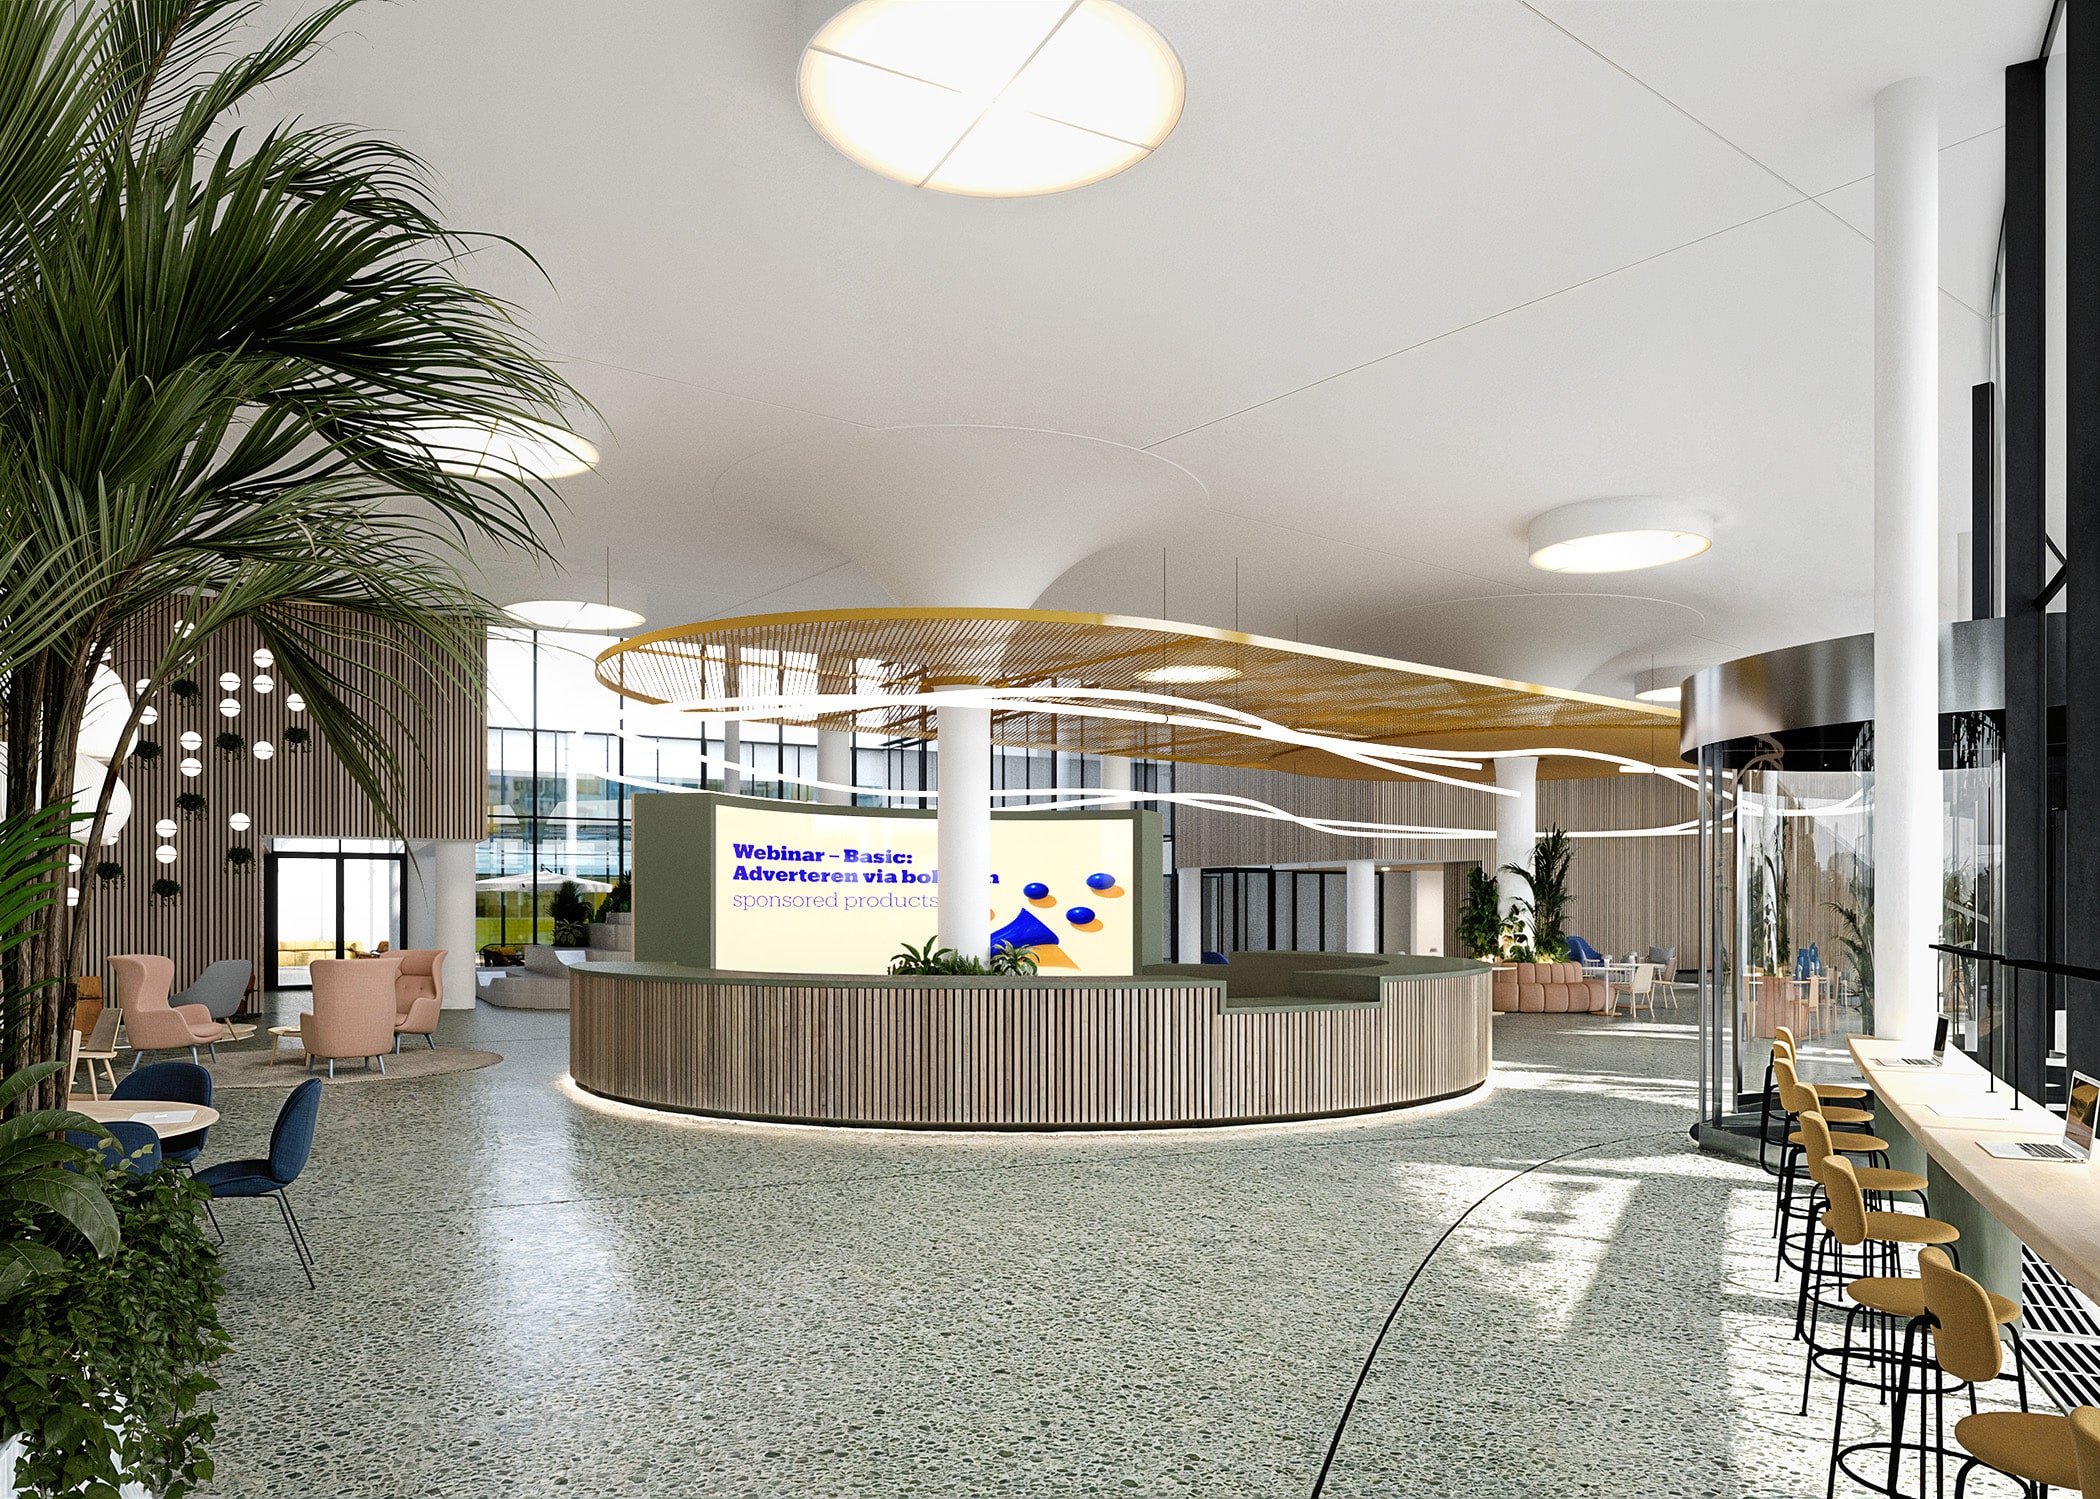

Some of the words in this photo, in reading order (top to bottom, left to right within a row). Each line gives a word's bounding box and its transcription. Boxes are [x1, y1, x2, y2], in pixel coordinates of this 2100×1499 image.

[733, 843, 825, 862] Webinar
[843, 849, 913, 864] Basic:
[733, 865, 859, 883] Adverteren
[863, 868, 898, 884] via
[733, 892, 839, 911] sponsored
[844, 892, 939, 911] products
